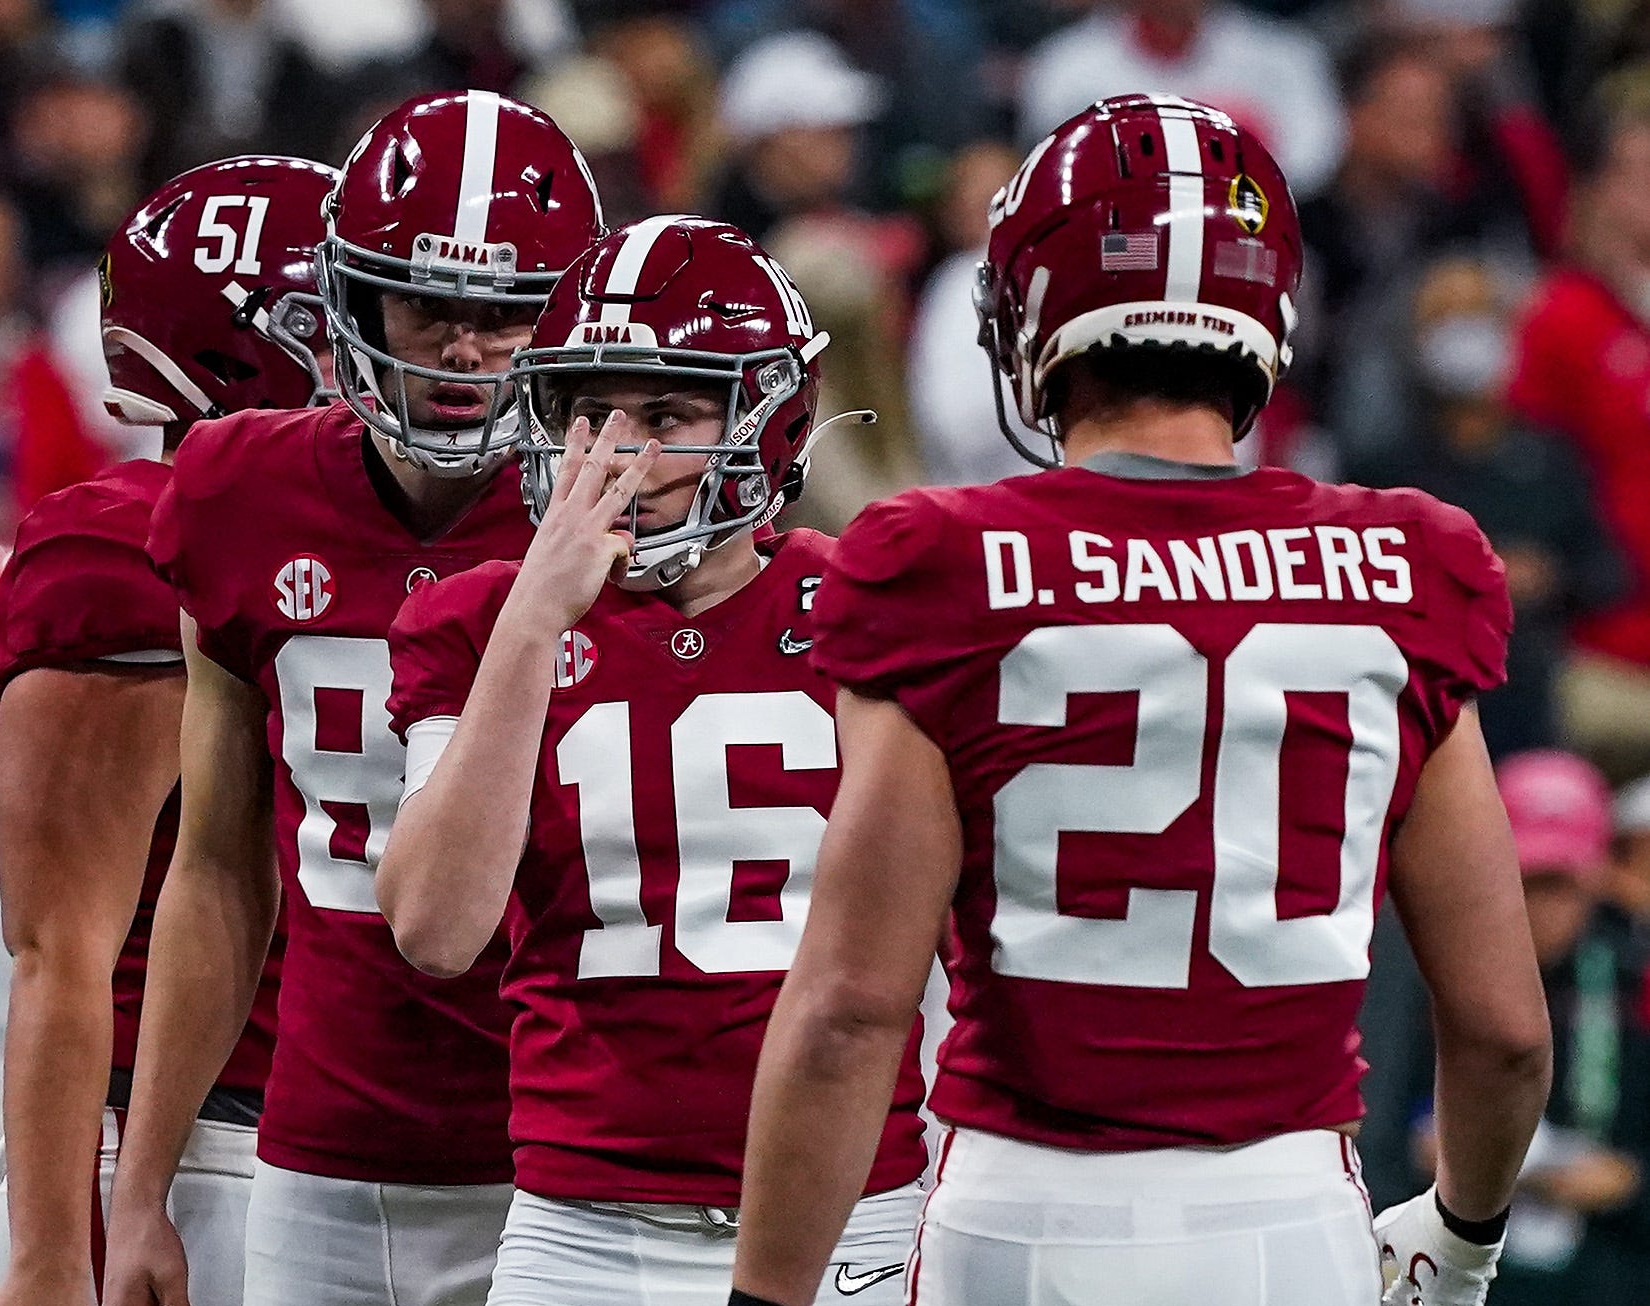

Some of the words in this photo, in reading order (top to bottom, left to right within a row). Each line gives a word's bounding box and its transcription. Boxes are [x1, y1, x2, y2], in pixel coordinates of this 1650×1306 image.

[194, 195, 270, 276] 51
[439, 241, 488, 265] BAMA
[584, 326, 632, 344] BAMA
[752, 255, 813, 340] 16
[273, 558, 333, 621] SEC
[982, 530, 1055, 610] D.
[1069, 525, 1414, 605] SANDERS
[551, 629, 595, 689] EC
[556, 691, 839, 980] 16
[991, 623, 1409, 990] 20
